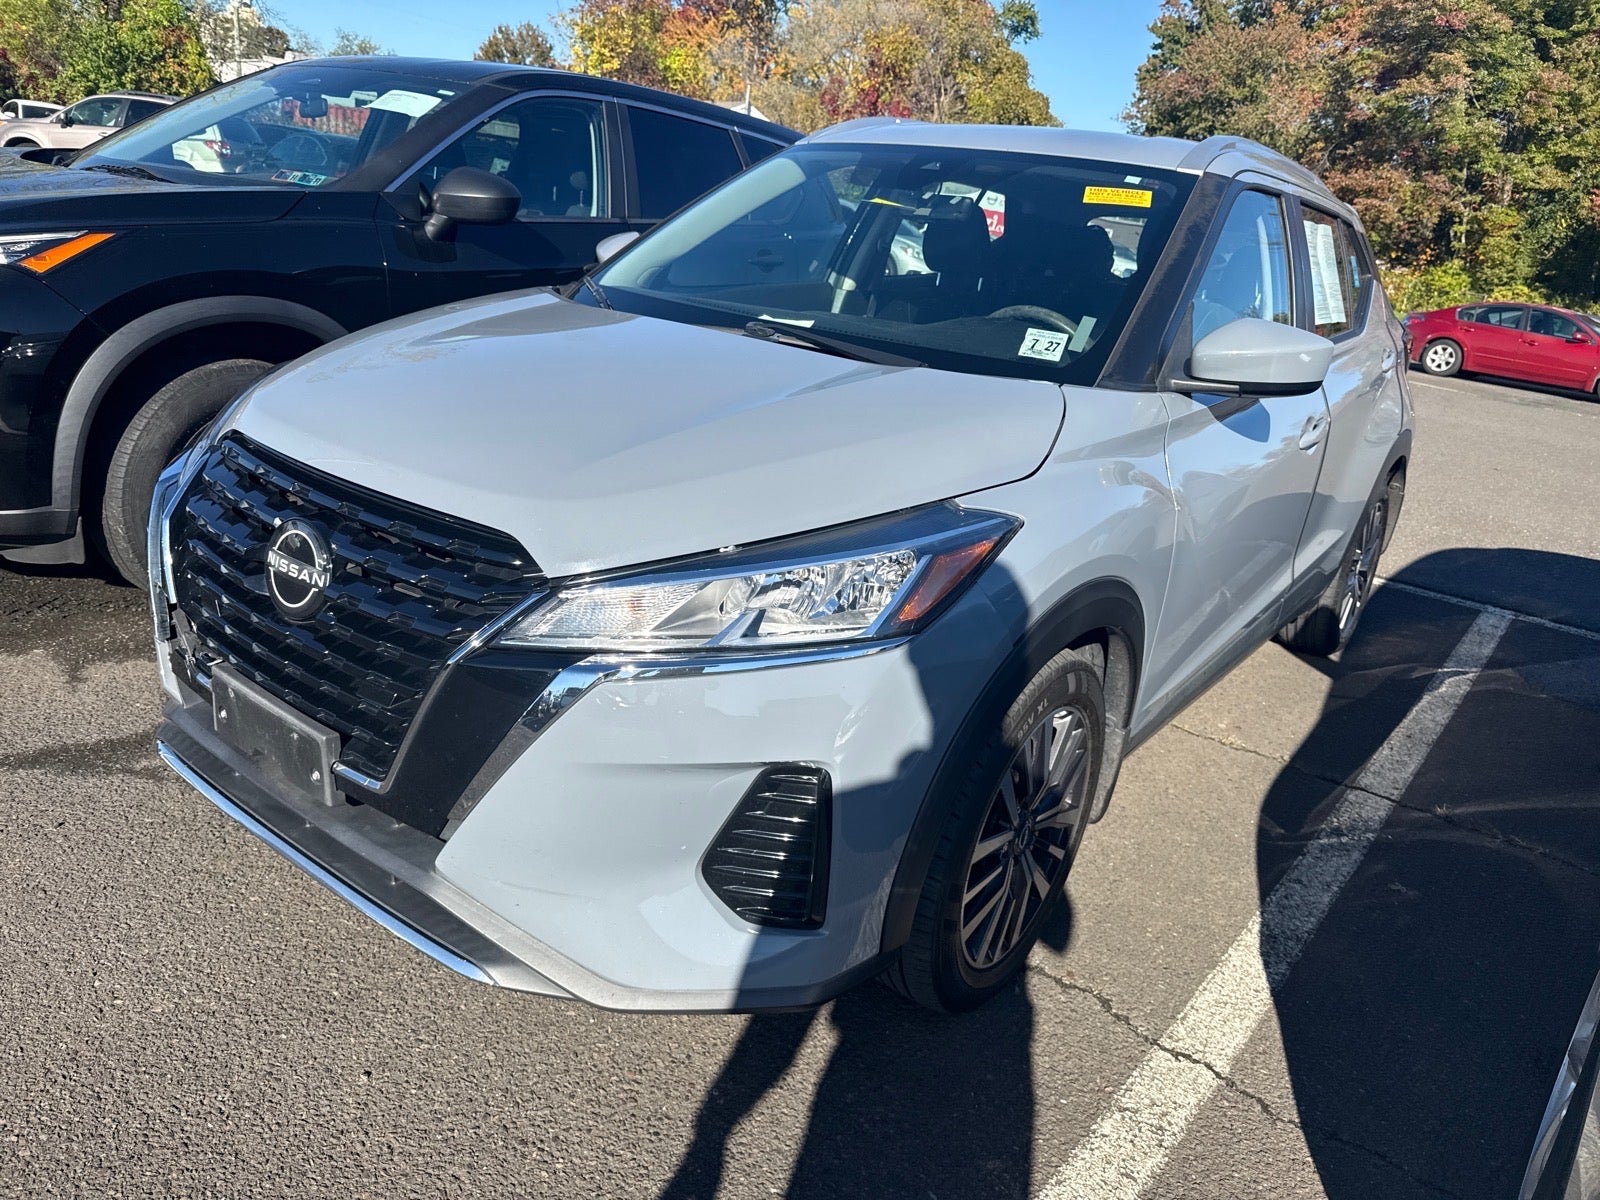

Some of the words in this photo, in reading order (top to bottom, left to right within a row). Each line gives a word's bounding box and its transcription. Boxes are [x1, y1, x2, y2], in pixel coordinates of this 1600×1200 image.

[1110, 188, 1146, 196] VEHICLE
[1030, 338, 1040, 350] 7
[1044, 340, 1062, 353] 27
[267, 550, 325, 588] NISSAN
[1017, 712, 1035, 741] 95V
[1036, 698, 1049, 715] XL
